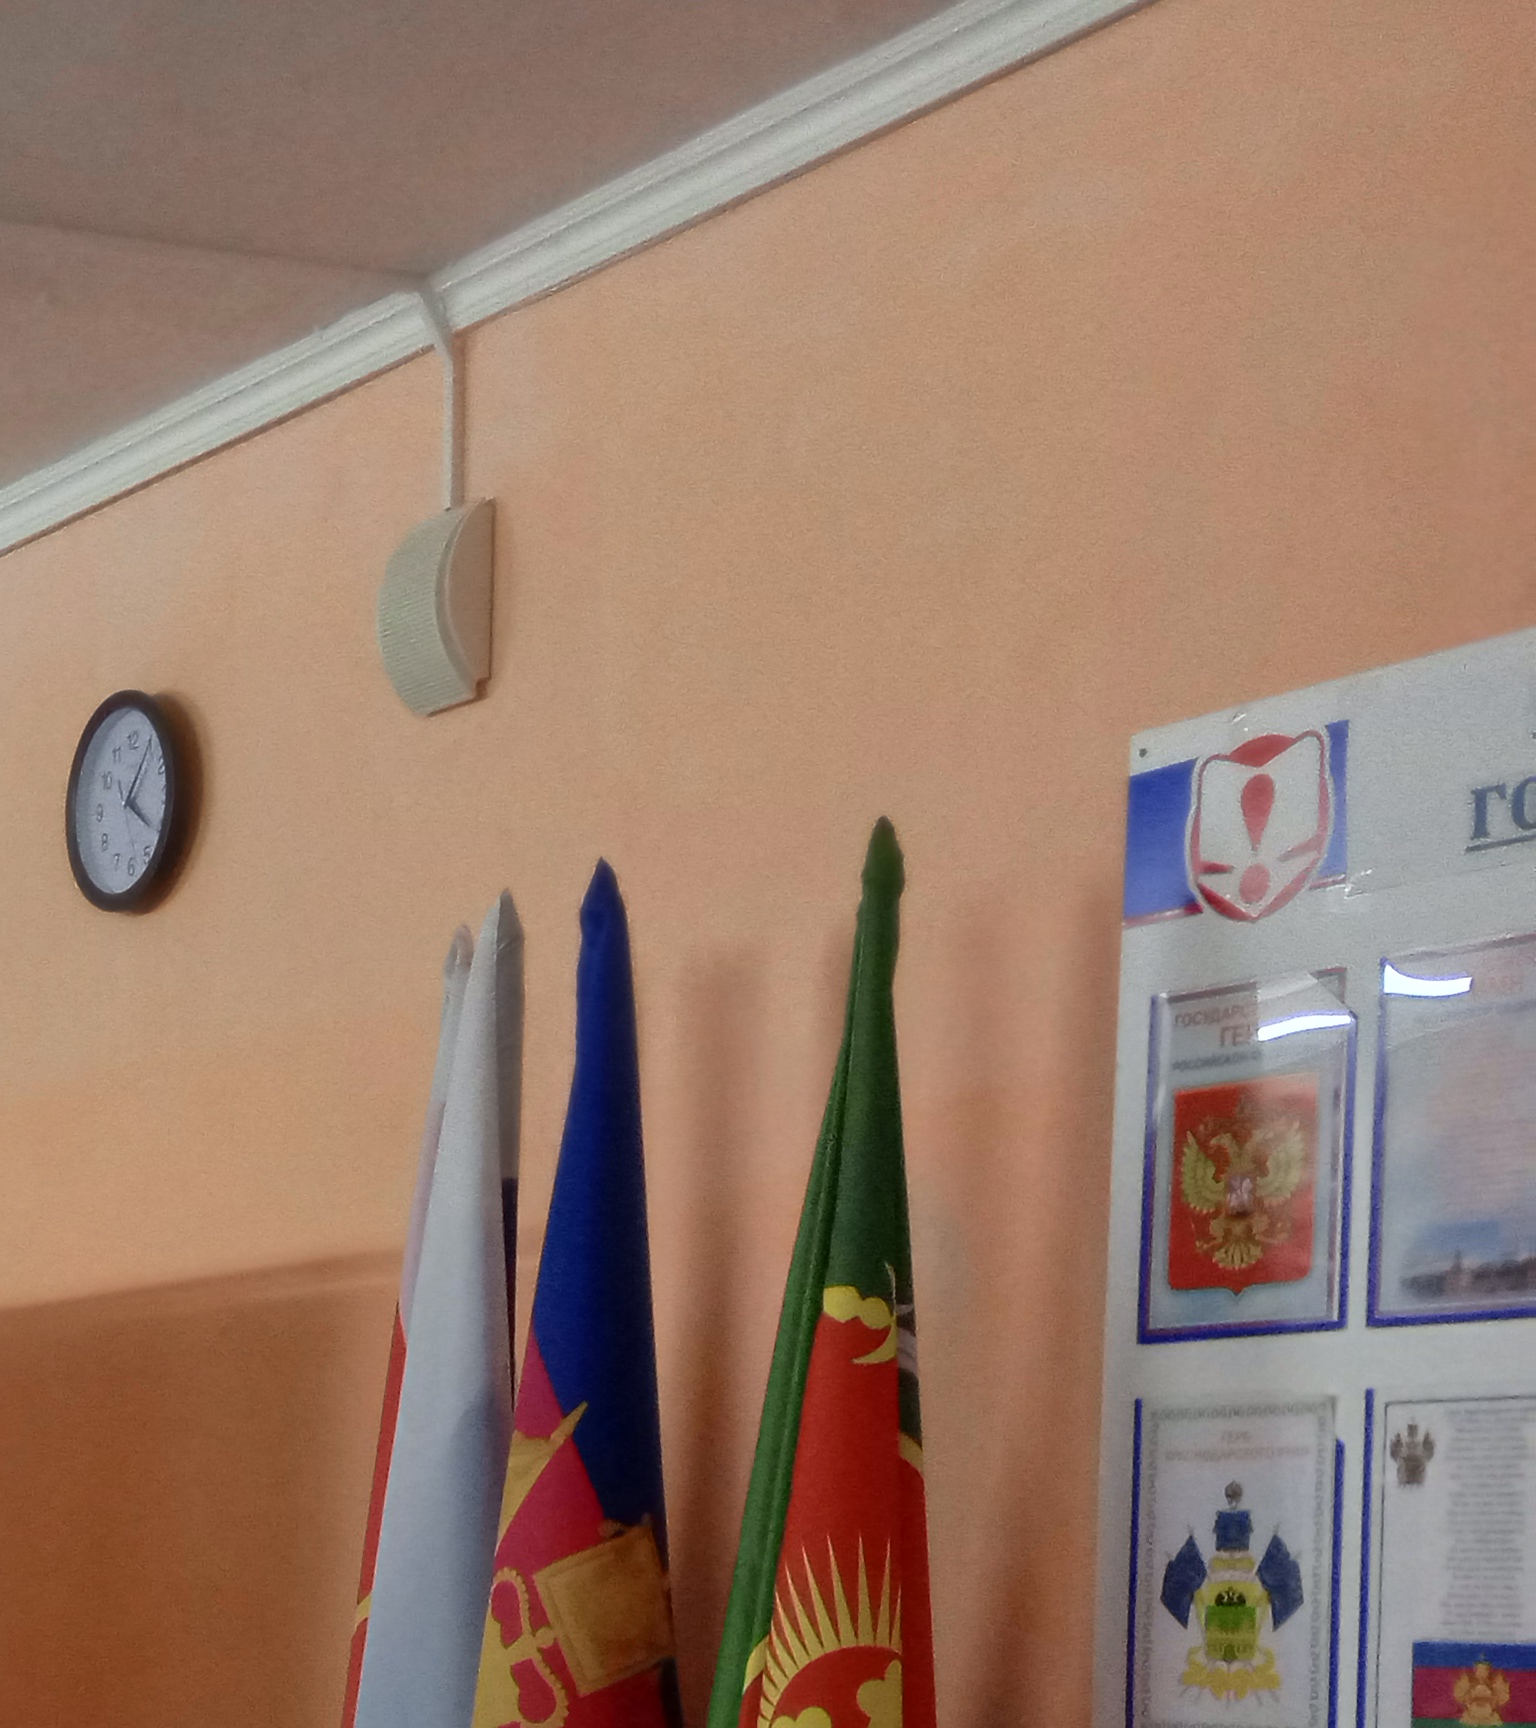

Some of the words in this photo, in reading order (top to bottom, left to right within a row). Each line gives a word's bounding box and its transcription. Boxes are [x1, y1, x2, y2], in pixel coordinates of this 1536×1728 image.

[127, 731, 139, 750] 12
[112, 746, 121, 763] 11
[102, 771, 113, 790] 10
[96, 803, 104, 822] 9
[101, 833, 109, 851] 8
[113, 853, 121, 871] 7
[128, 857, 135, 876] 6
